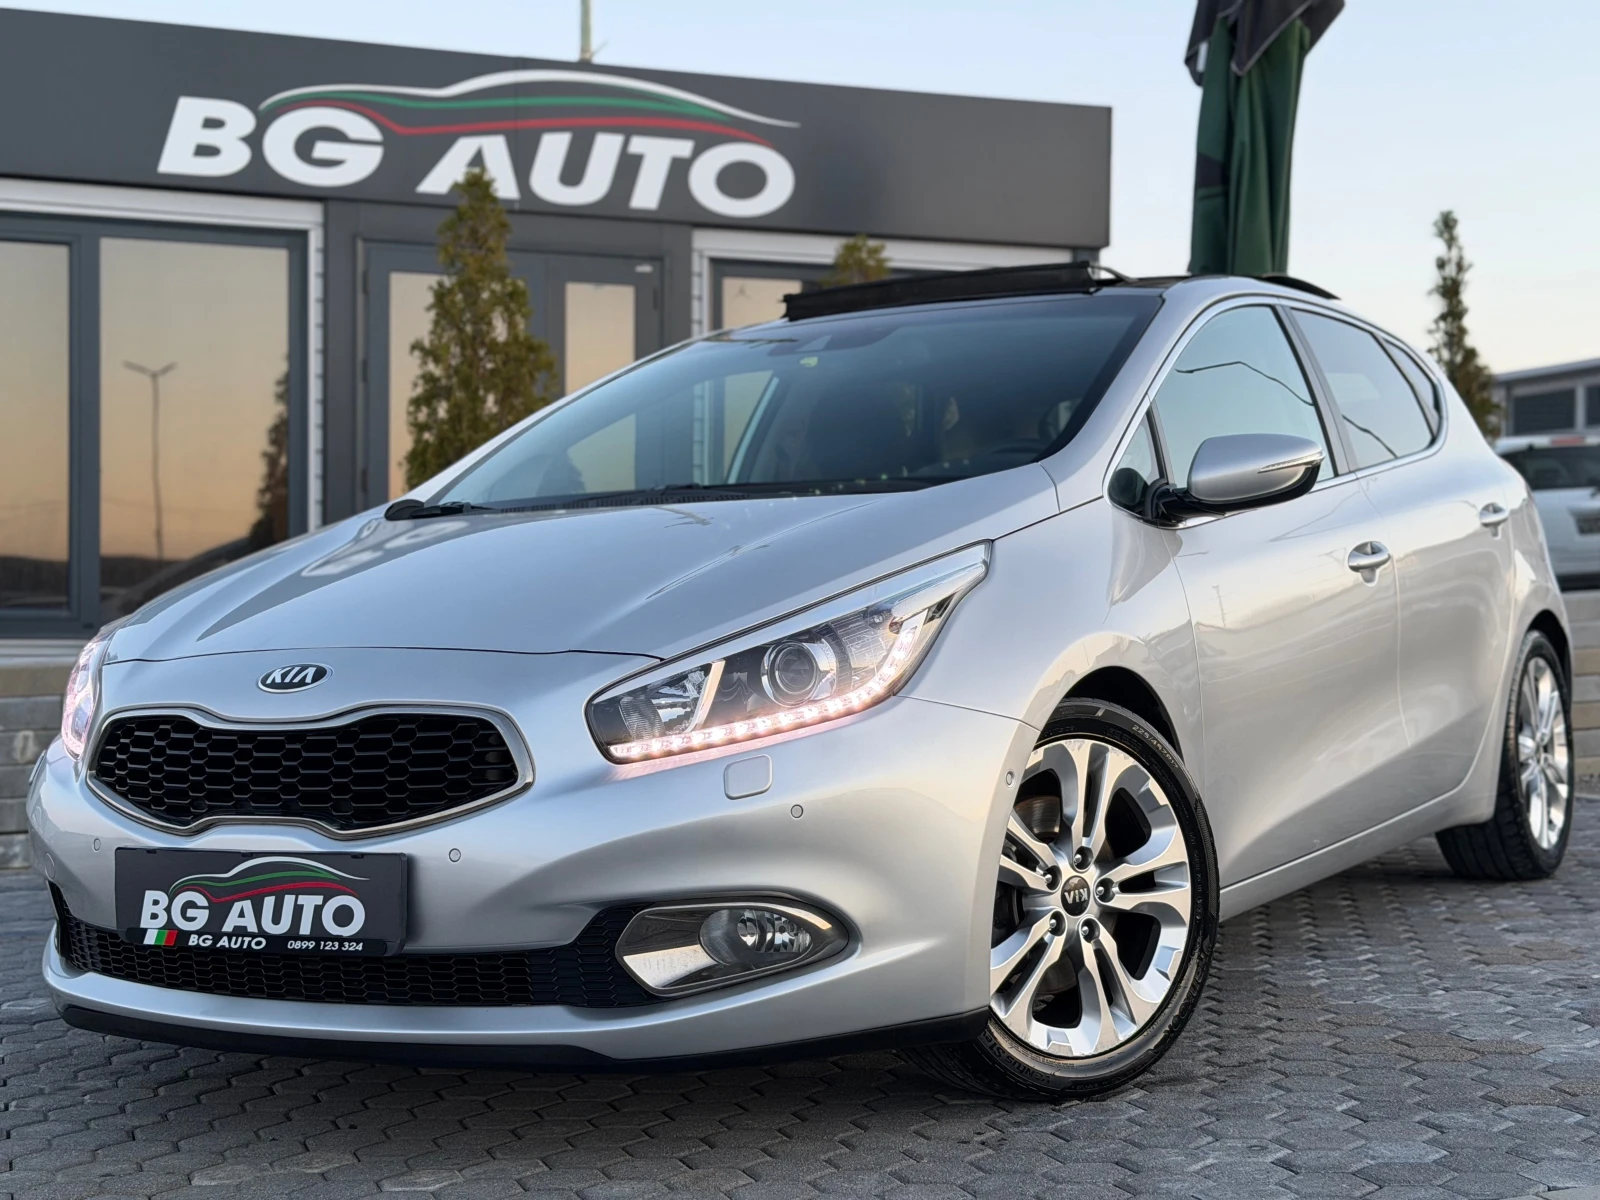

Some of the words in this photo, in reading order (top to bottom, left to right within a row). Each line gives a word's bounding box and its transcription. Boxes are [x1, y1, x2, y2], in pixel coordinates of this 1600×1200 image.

[157, 95, 384, 188] BG
[416, 131, 795, 218] AUTO
[265, 666, 317, 685] KIA
[1064, 887, 1089, 905] KIA
[140, 890, 210, 931] BG
[221, 894, 366, 937] AUTO
[188, 933, 213, 948] BG
[216, 936, 267, 950] AUTO
[287, 940, 316, 950] 0899
[319, 941, 339, 951] 123
[341, 942, 364, 951] 324
